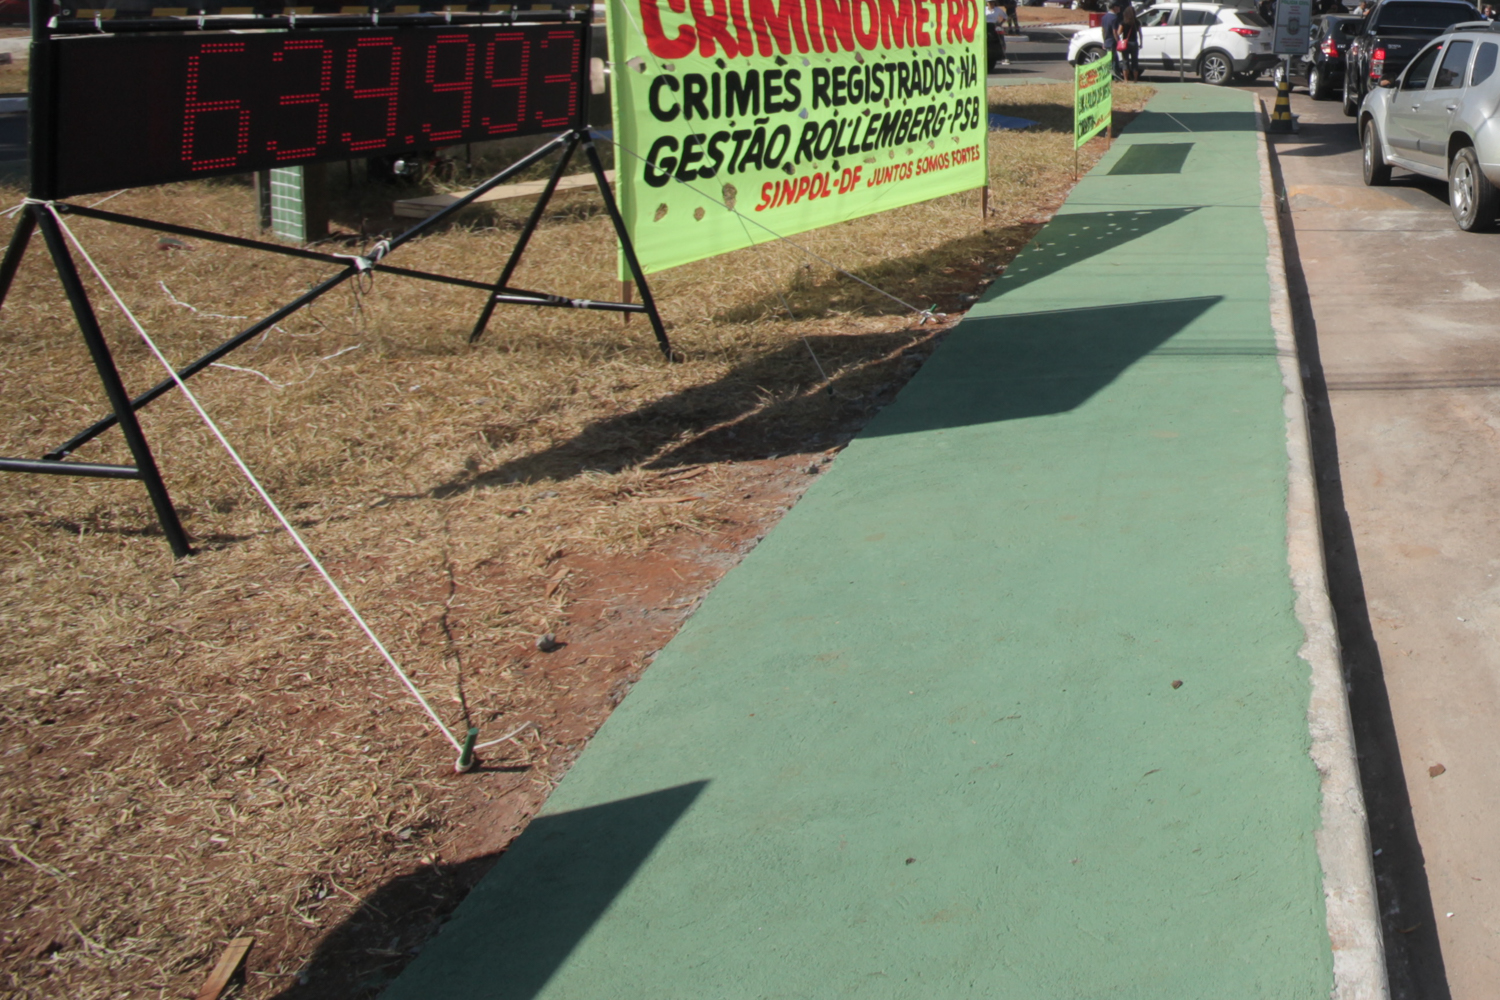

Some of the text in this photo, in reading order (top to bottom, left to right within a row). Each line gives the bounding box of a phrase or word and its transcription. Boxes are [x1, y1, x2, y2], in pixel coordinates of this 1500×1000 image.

[649, 54, 977, 122] CRIMES REGISTRADOS NA
[644, 117, 791, 187] GESTÃO
[755, 144, 980, 212] SINPOL-DF JUNTOS SOMOS FORTES
